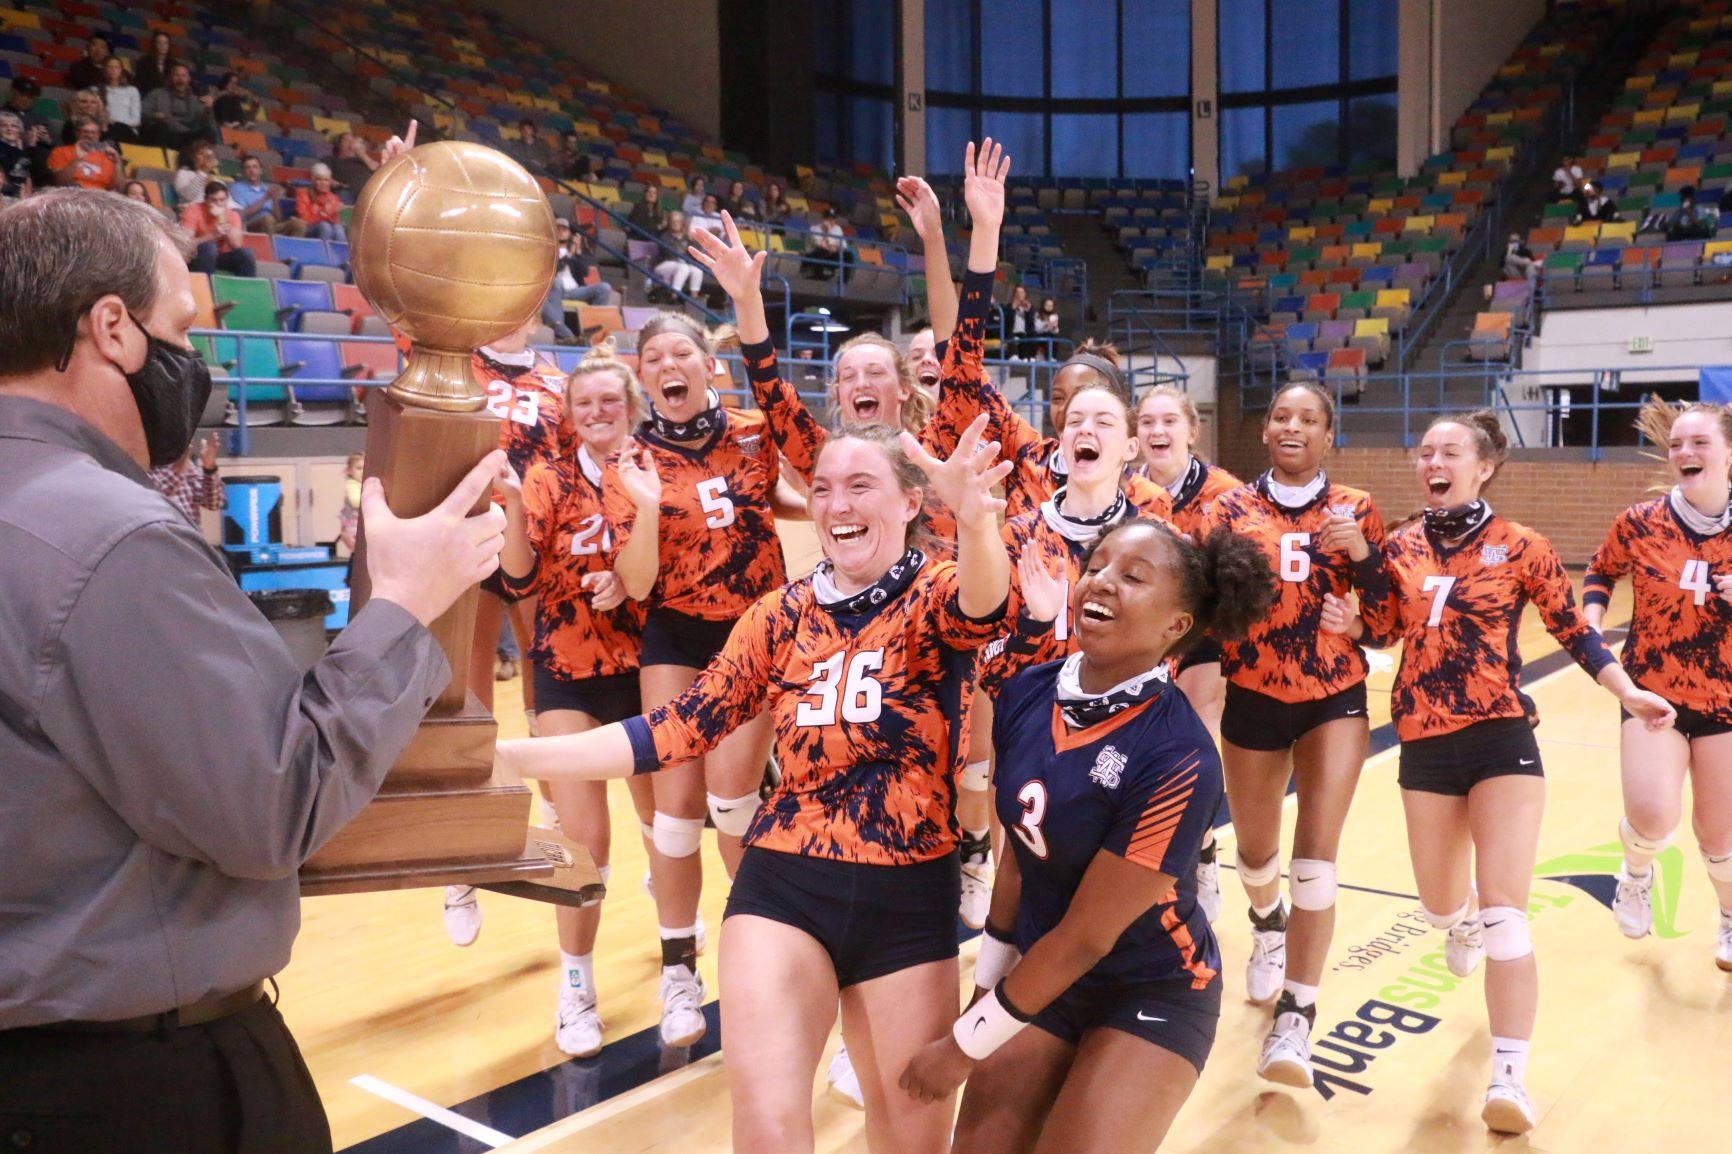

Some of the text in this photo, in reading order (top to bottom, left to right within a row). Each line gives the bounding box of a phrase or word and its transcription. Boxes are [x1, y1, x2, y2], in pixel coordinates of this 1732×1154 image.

[910, 94, 920, 110] K
[1200, 102, 1209, 116] L
[1632, 336, 1649, 349] EXIT
[487, 379, 539, 427] 23
[695, 475, 735, 529] 5
[570, 512, 611, 556] 2
[1280, 532, 1311, 582] 6
[1422, 575, 1457, 627] 7
[1679, 559, 1711, 606] 4
[796, 646, 885, 727] 36
[1011, 779, 1050, 861] 3
[1332, 922, 1428, 971] Bridges.
